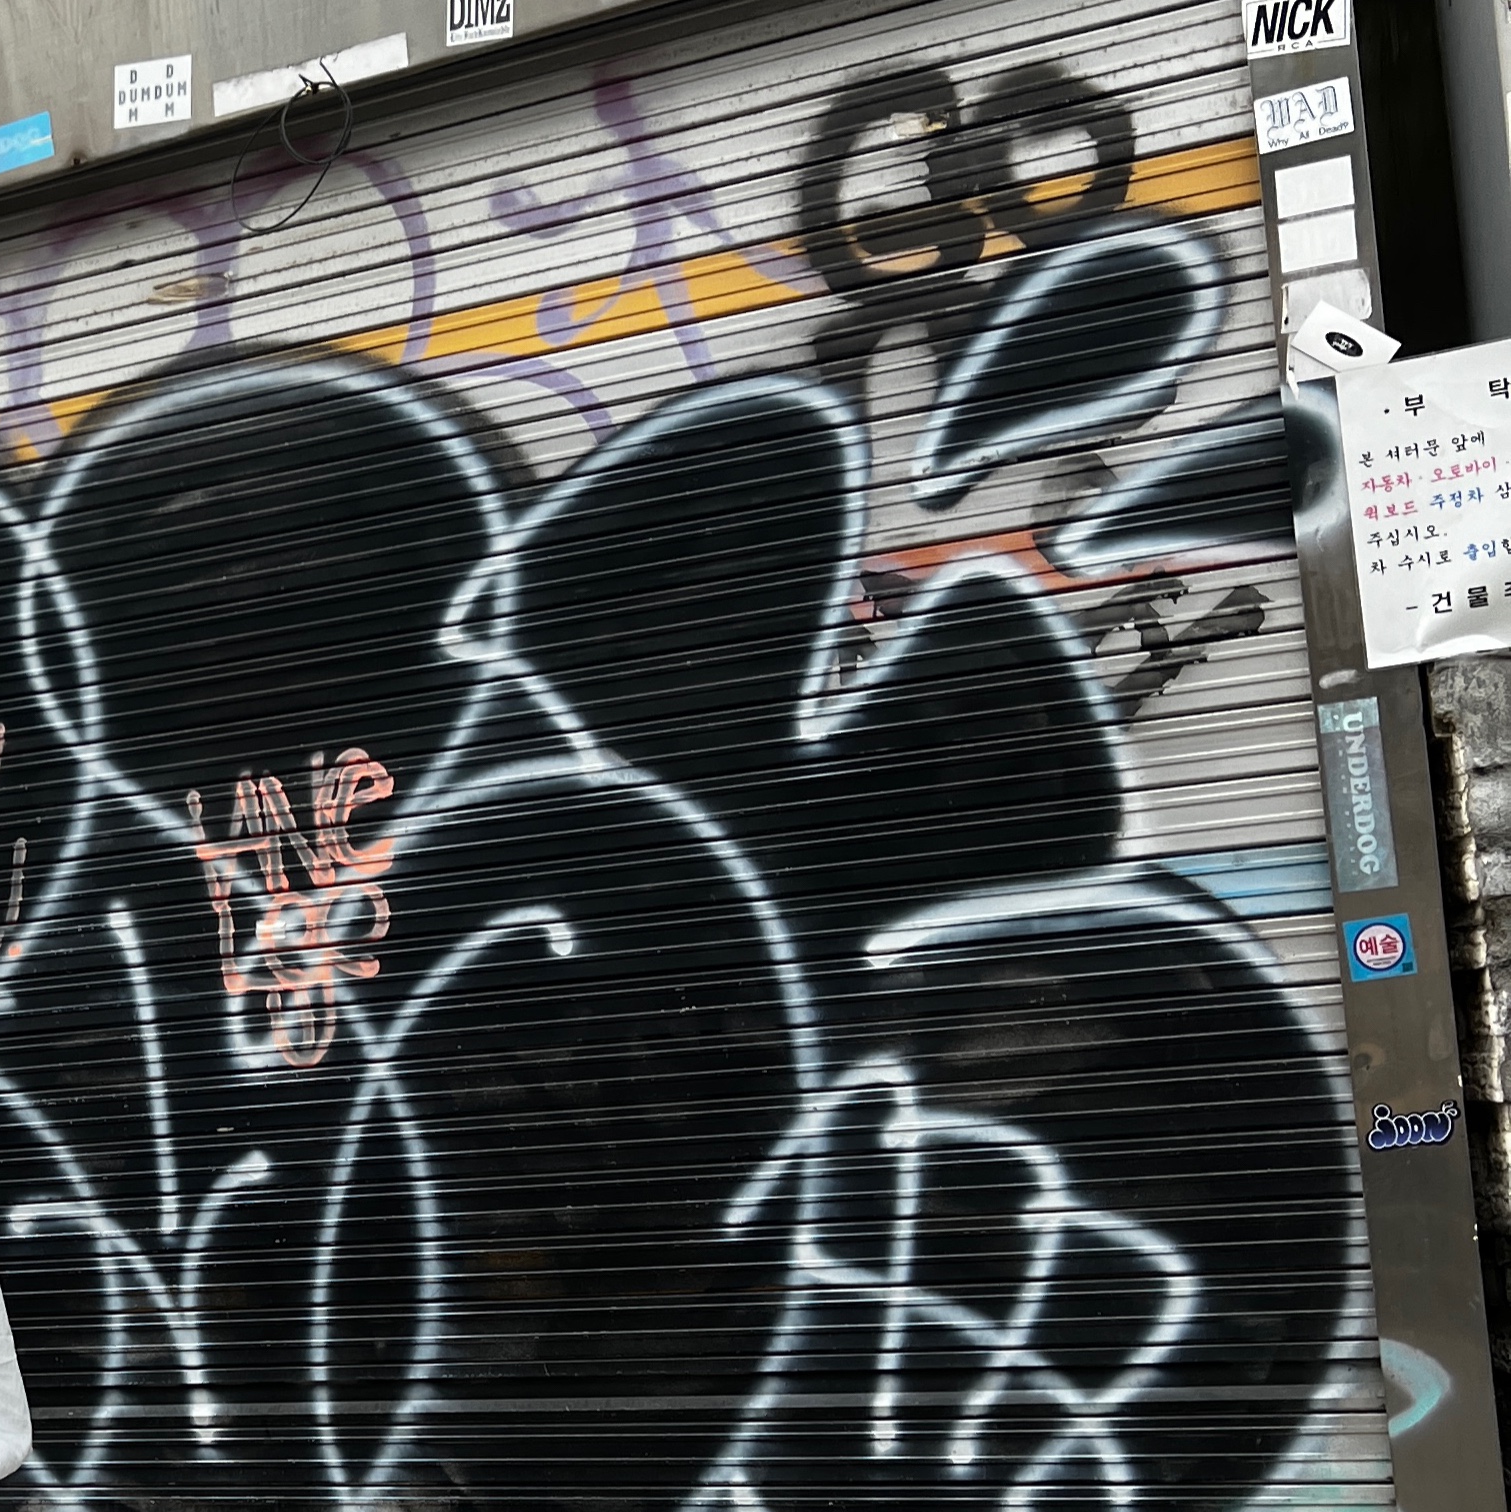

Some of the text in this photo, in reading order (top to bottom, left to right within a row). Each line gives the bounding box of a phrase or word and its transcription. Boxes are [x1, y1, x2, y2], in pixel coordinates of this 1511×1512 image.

[1252, 0, 1335, 46] NICK
[1359, 430, 1485, 468] 본 셔터문 앞에
[1361, 456, 1497, 493] 자동차 오토바이
[1429, 487, 1485, 510] 주정차
[1370, 559, 1387, 575] 차
[1398, 550, 1452, 571] 수시로
[1343, 711, 1381, 875] UNDERDOG
[1359, 934, 1400, 956] 예술
